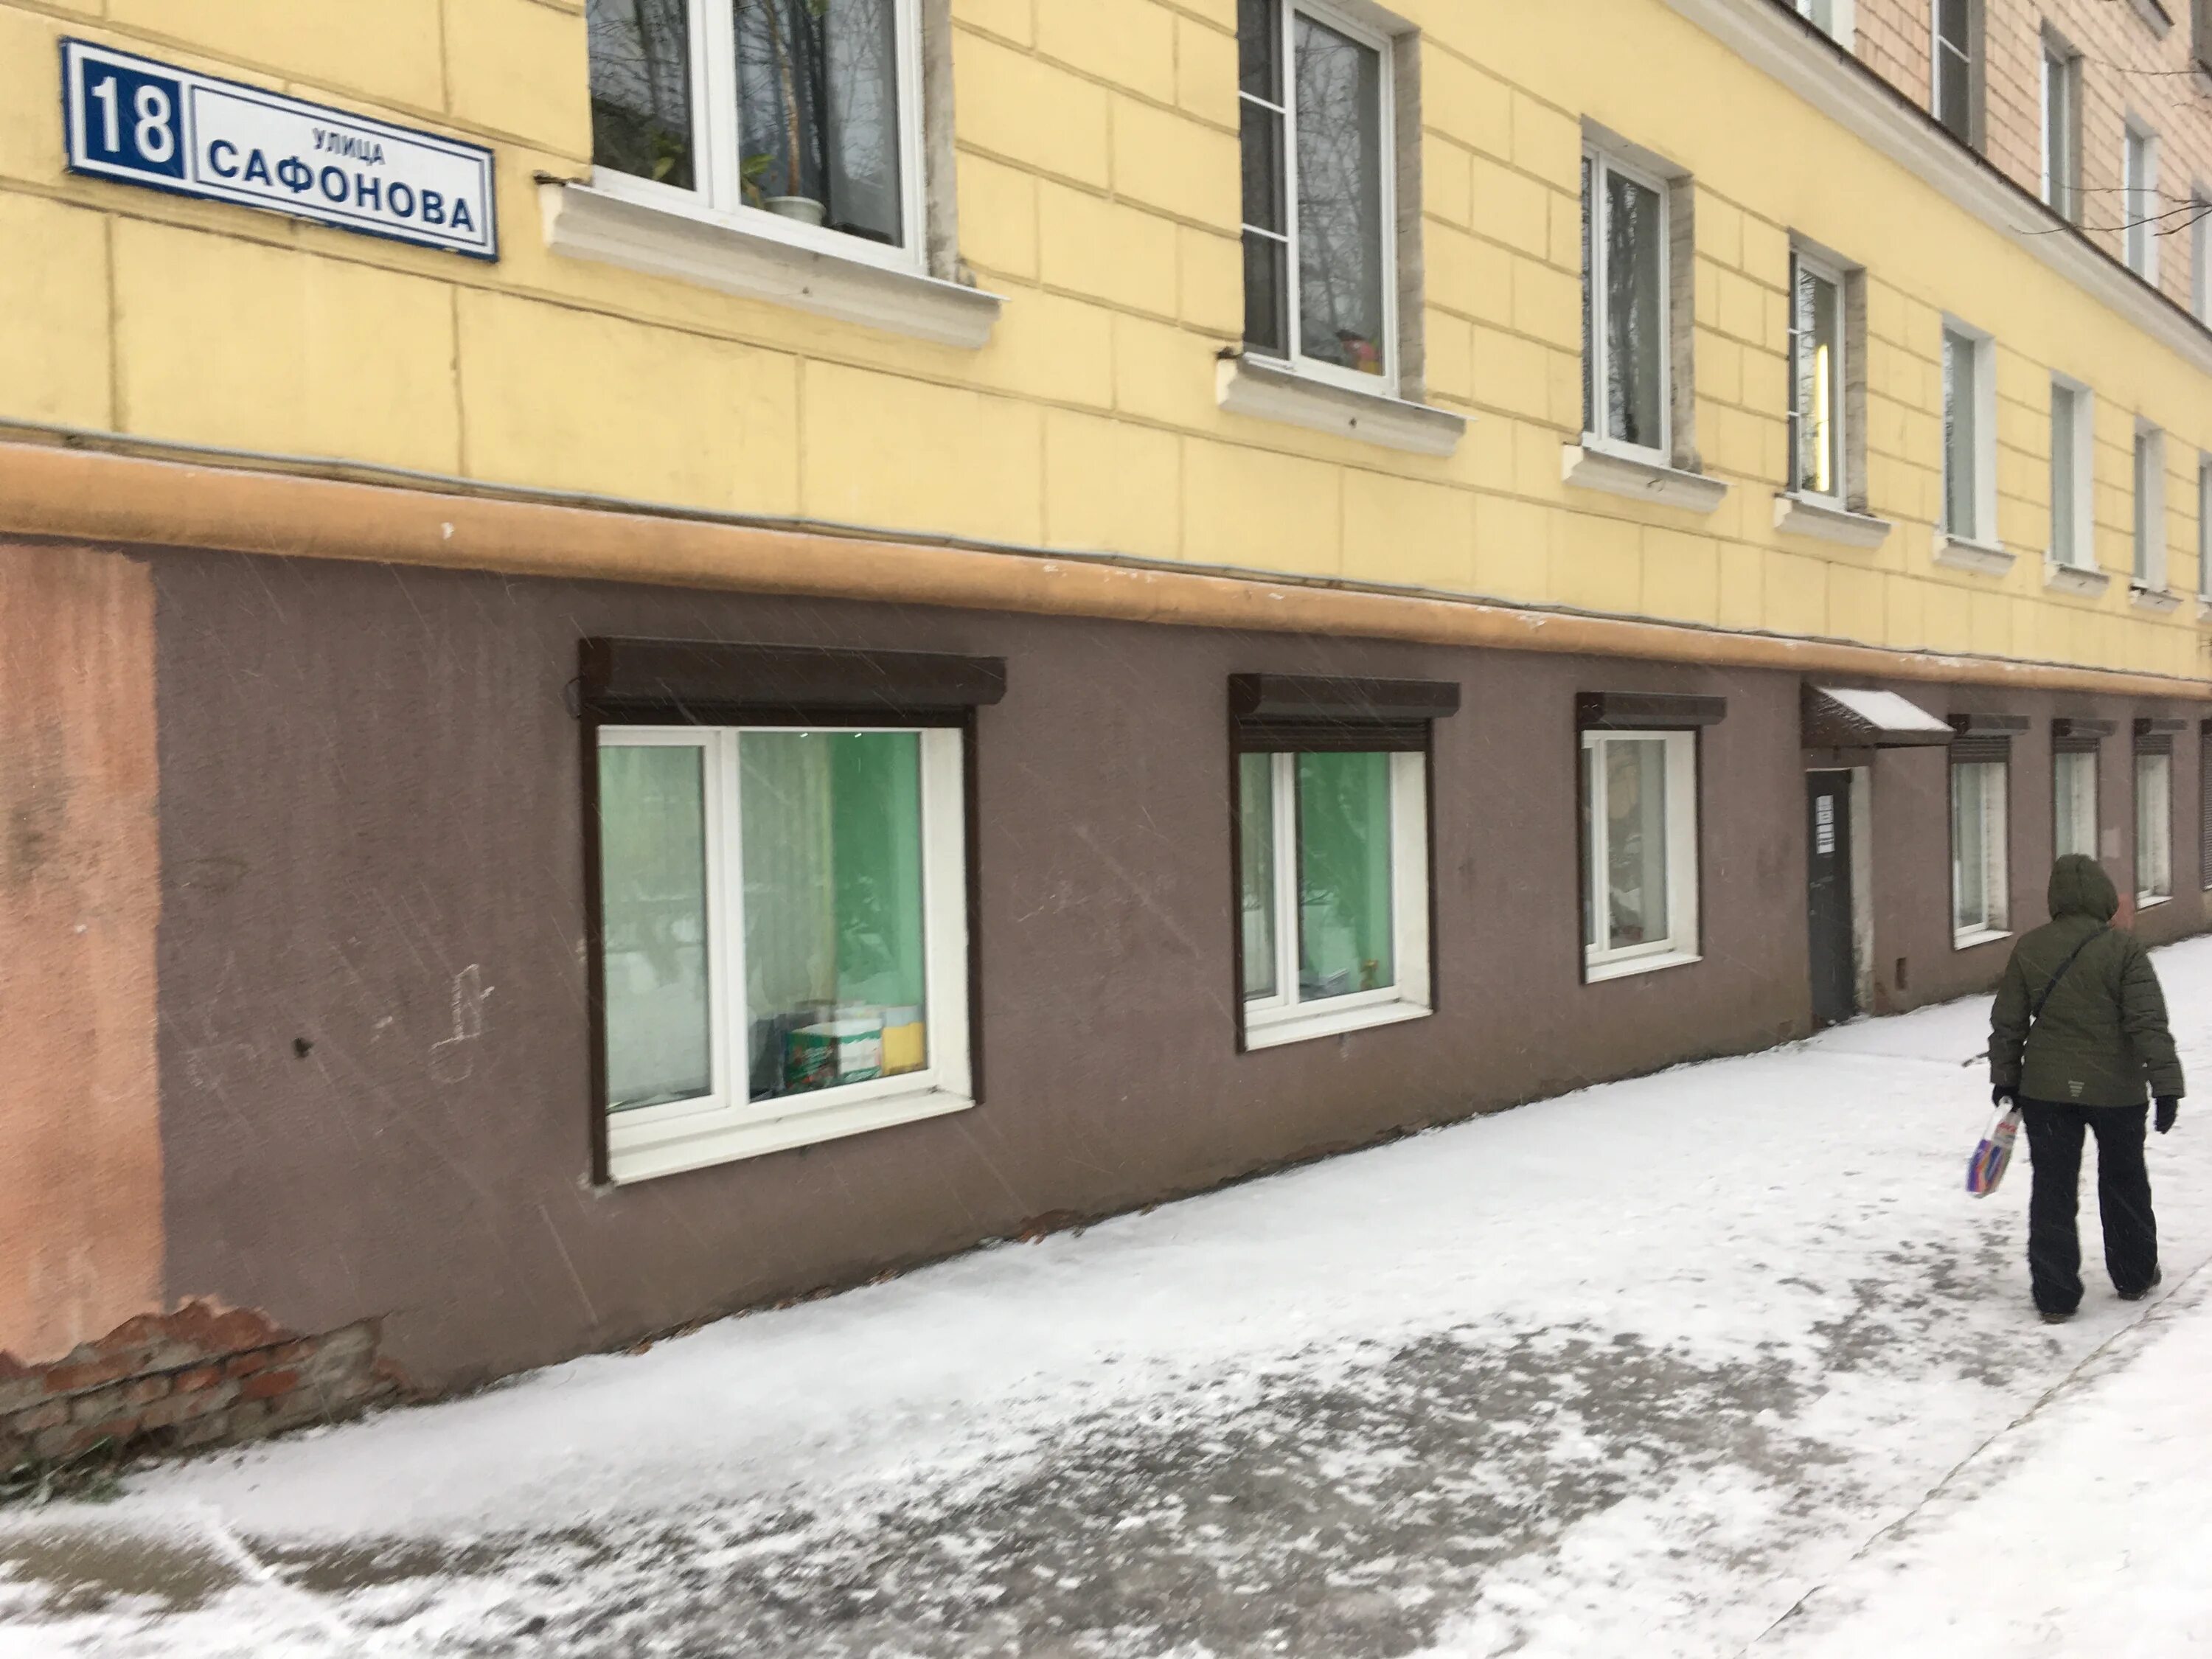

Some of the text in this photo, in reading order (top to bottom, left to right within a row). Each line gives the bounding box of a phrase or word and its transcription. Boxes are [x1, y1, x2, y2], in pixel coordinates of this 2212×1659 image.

[91, 76, 175, 164] 18
[313, 128, 386, 166] УЛИЦА
[207, 139, 475, 232] САФОНОВА
